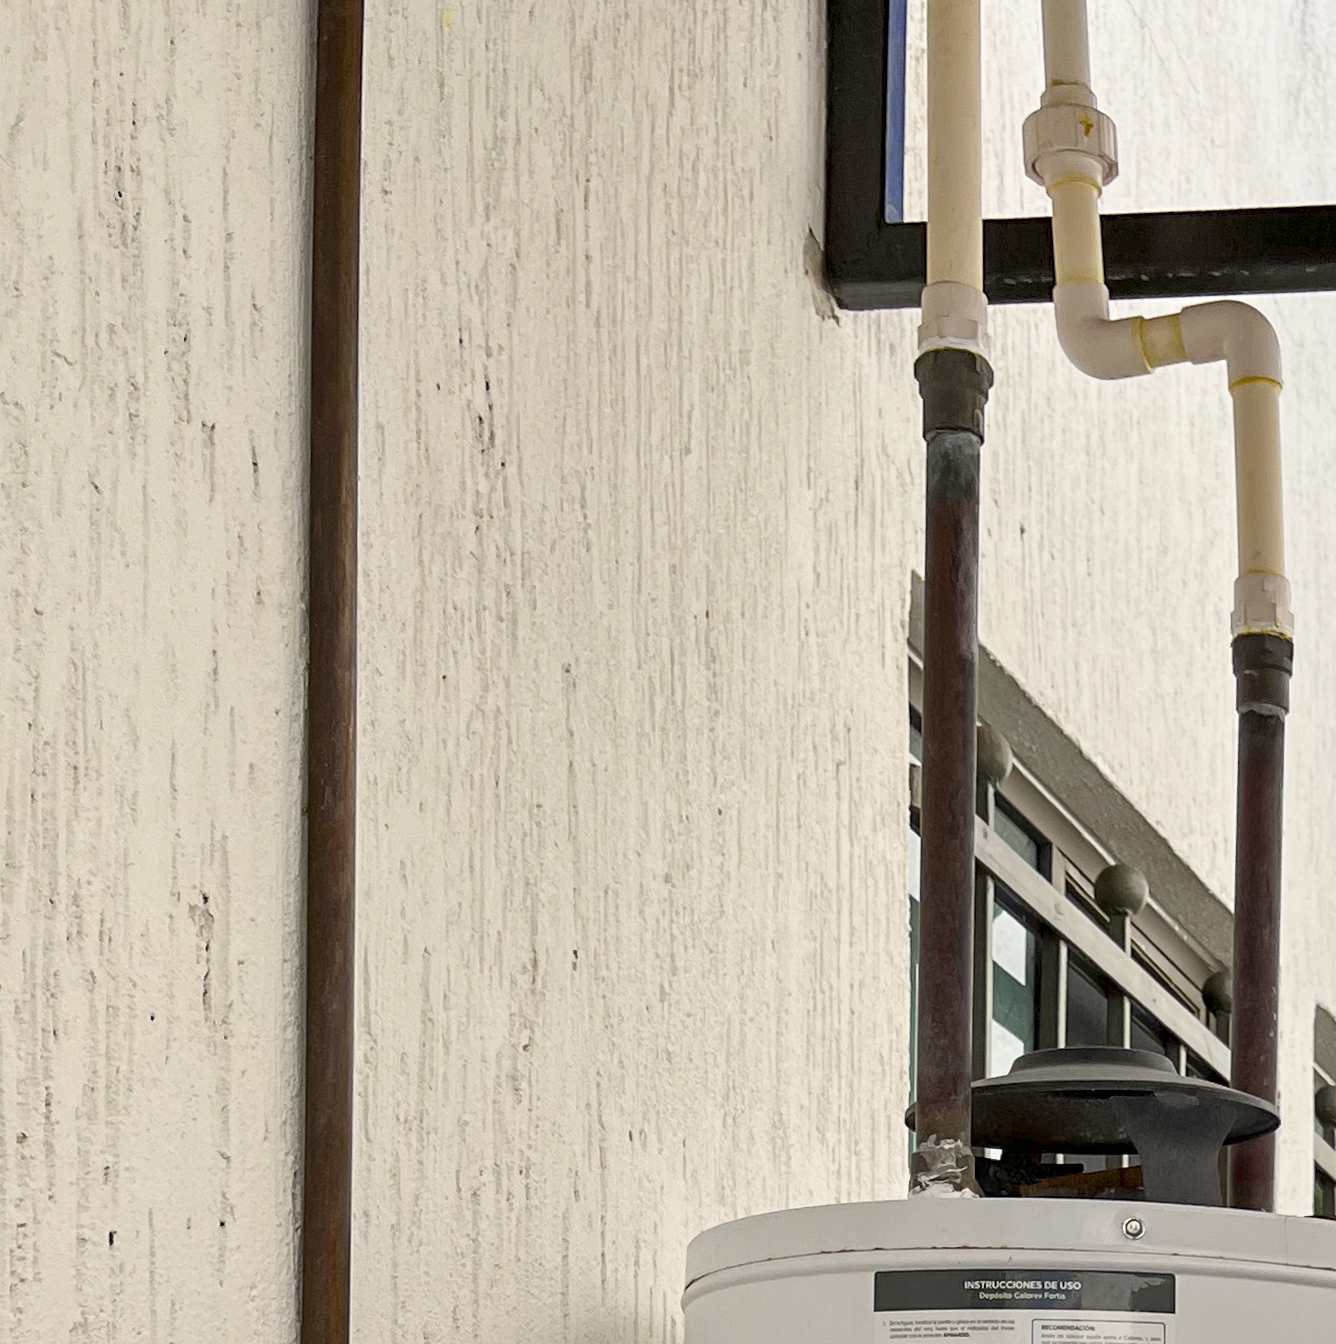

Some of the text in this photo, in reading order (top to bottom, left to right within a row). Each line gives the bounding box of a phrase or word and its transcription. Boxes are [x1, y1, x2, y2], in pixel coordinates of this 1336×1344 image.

[964, 1281, 1081, 1290] INSTRUCCIONES DE USO
